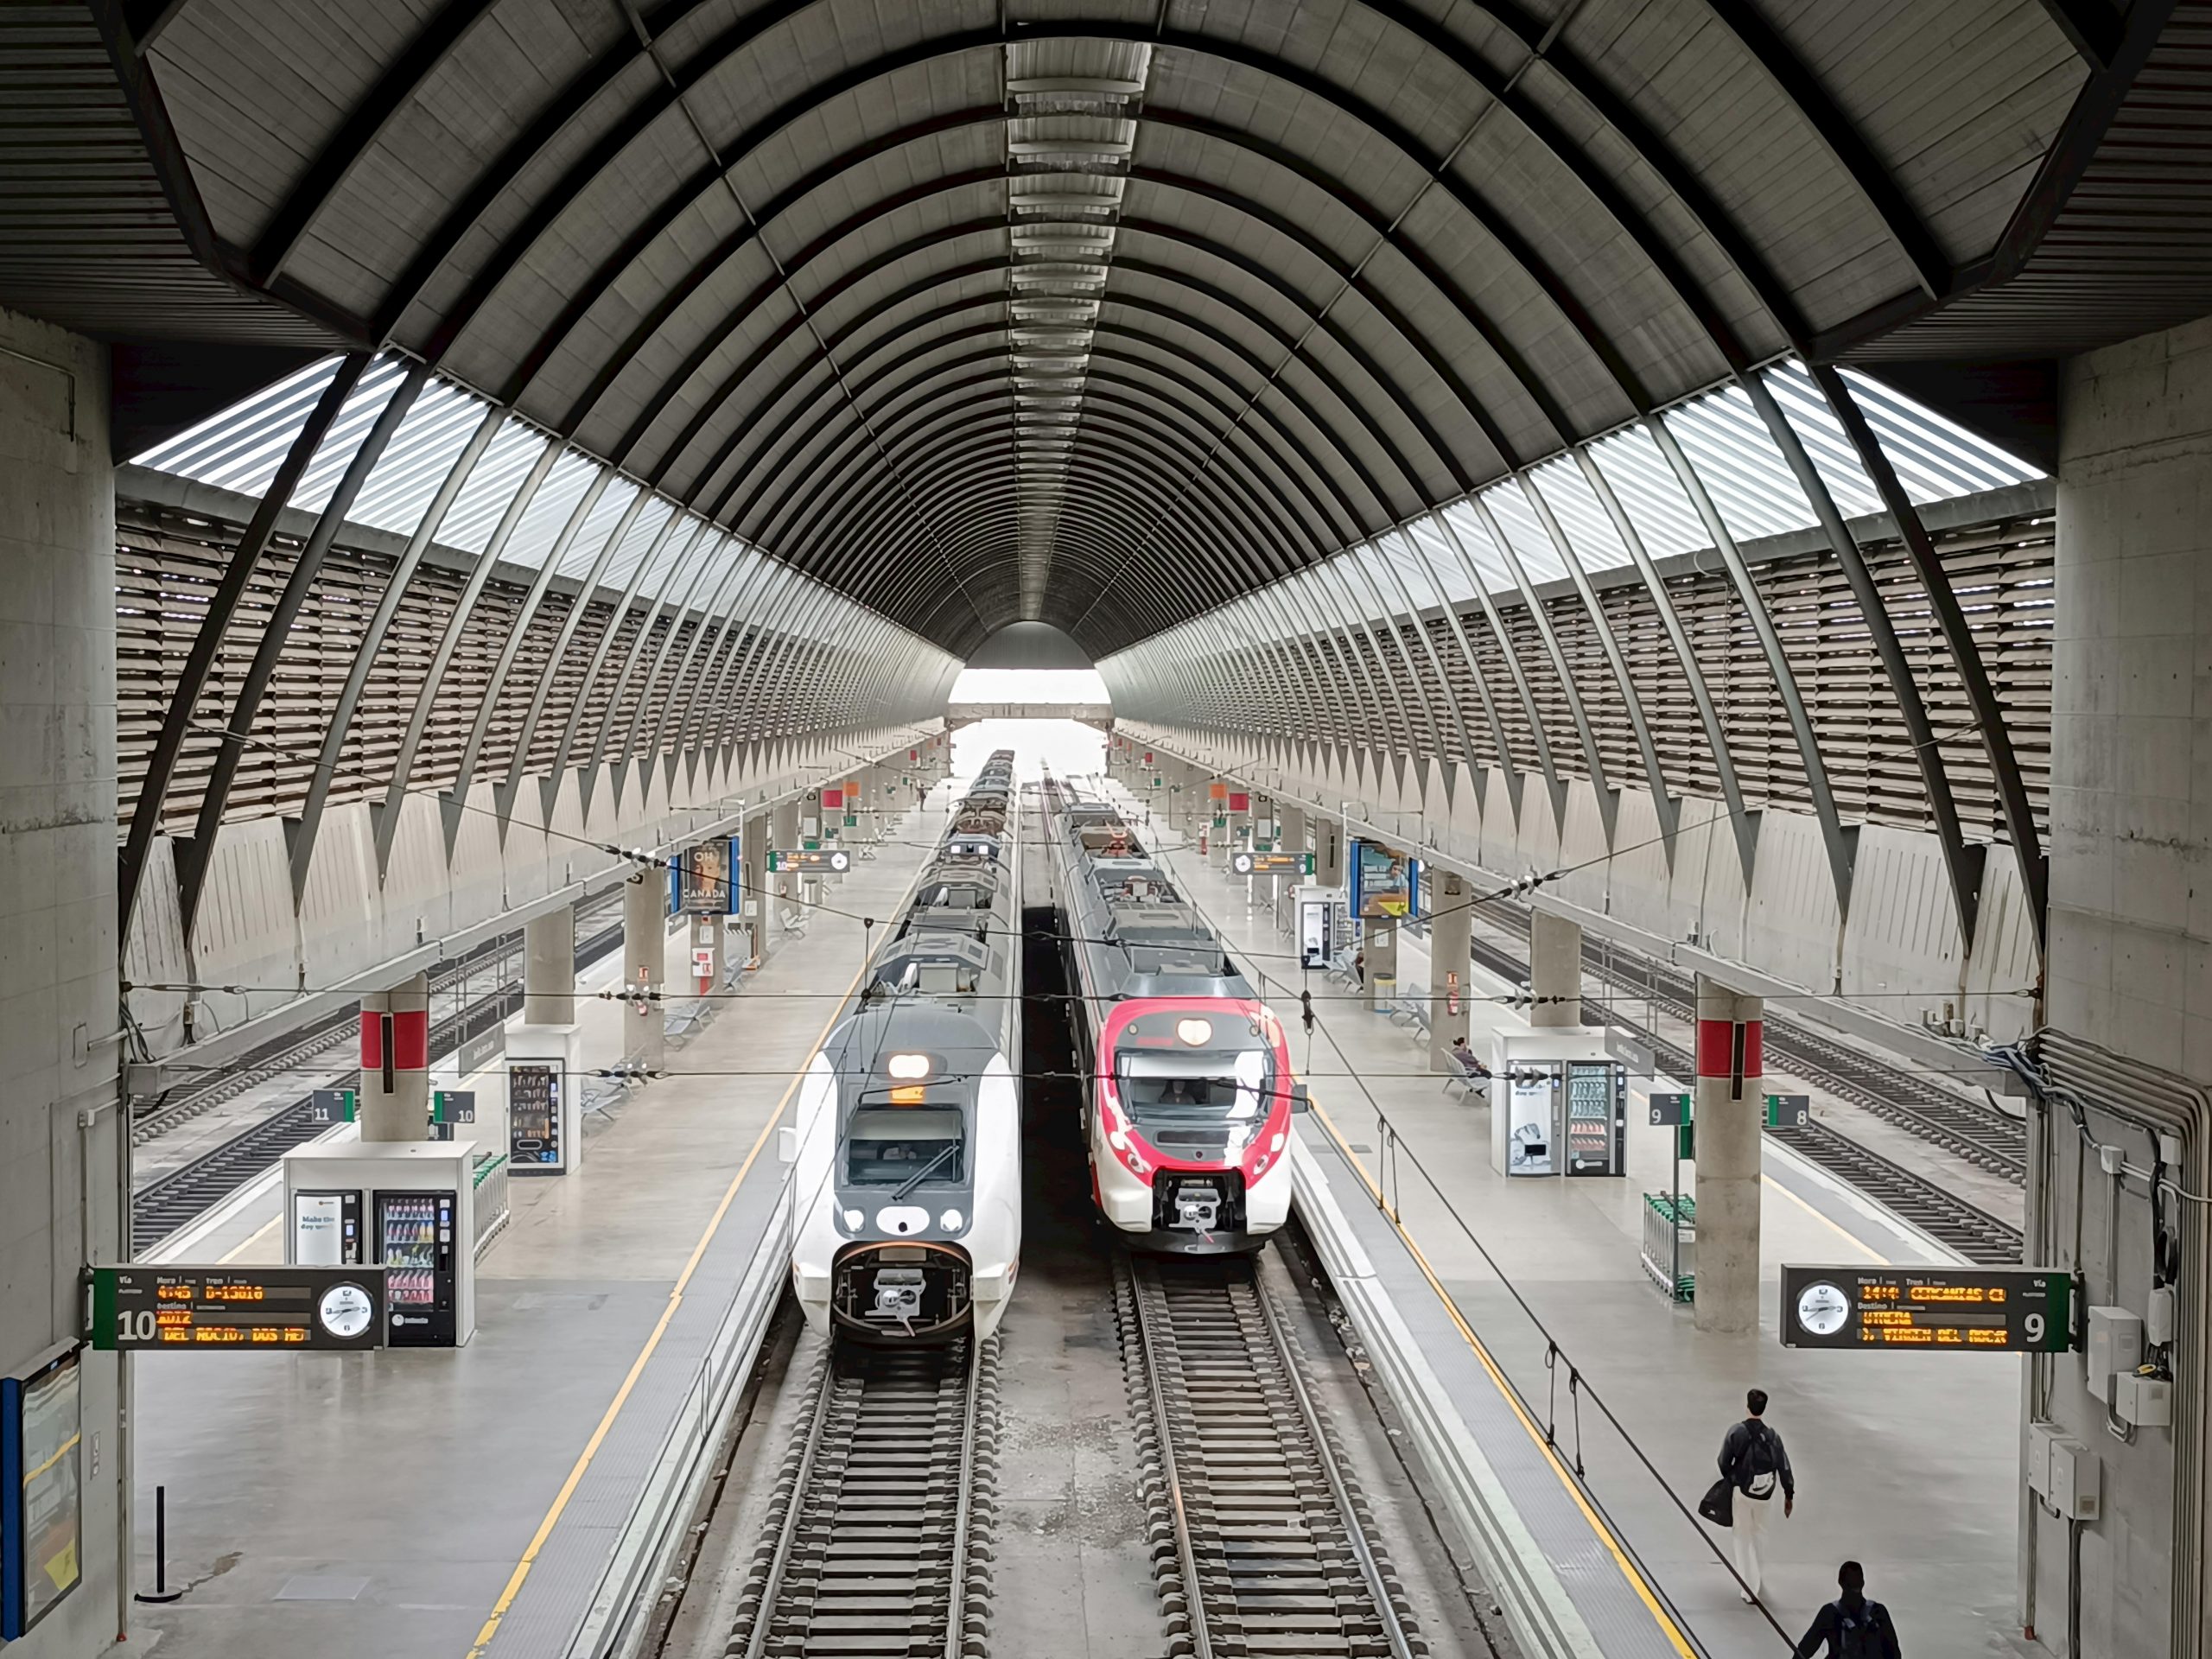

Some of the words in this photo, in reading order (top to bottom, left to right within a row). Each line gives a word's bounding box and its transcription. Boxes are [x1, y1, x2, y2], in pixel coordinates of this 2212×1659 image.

[694, 851, 714, 862] OH
[682, 888, 726, 899] CANADA
[315, 1108, 329, 1121] 11
[458, 1109, 474, 1122] 10
[1651, 1109, 1662, 1123] 9
[1796, 1109, 1807, 1125] 8
[118, 1310, 156, 1341] 10
[2024, 1313, 2045, 1343] 9
